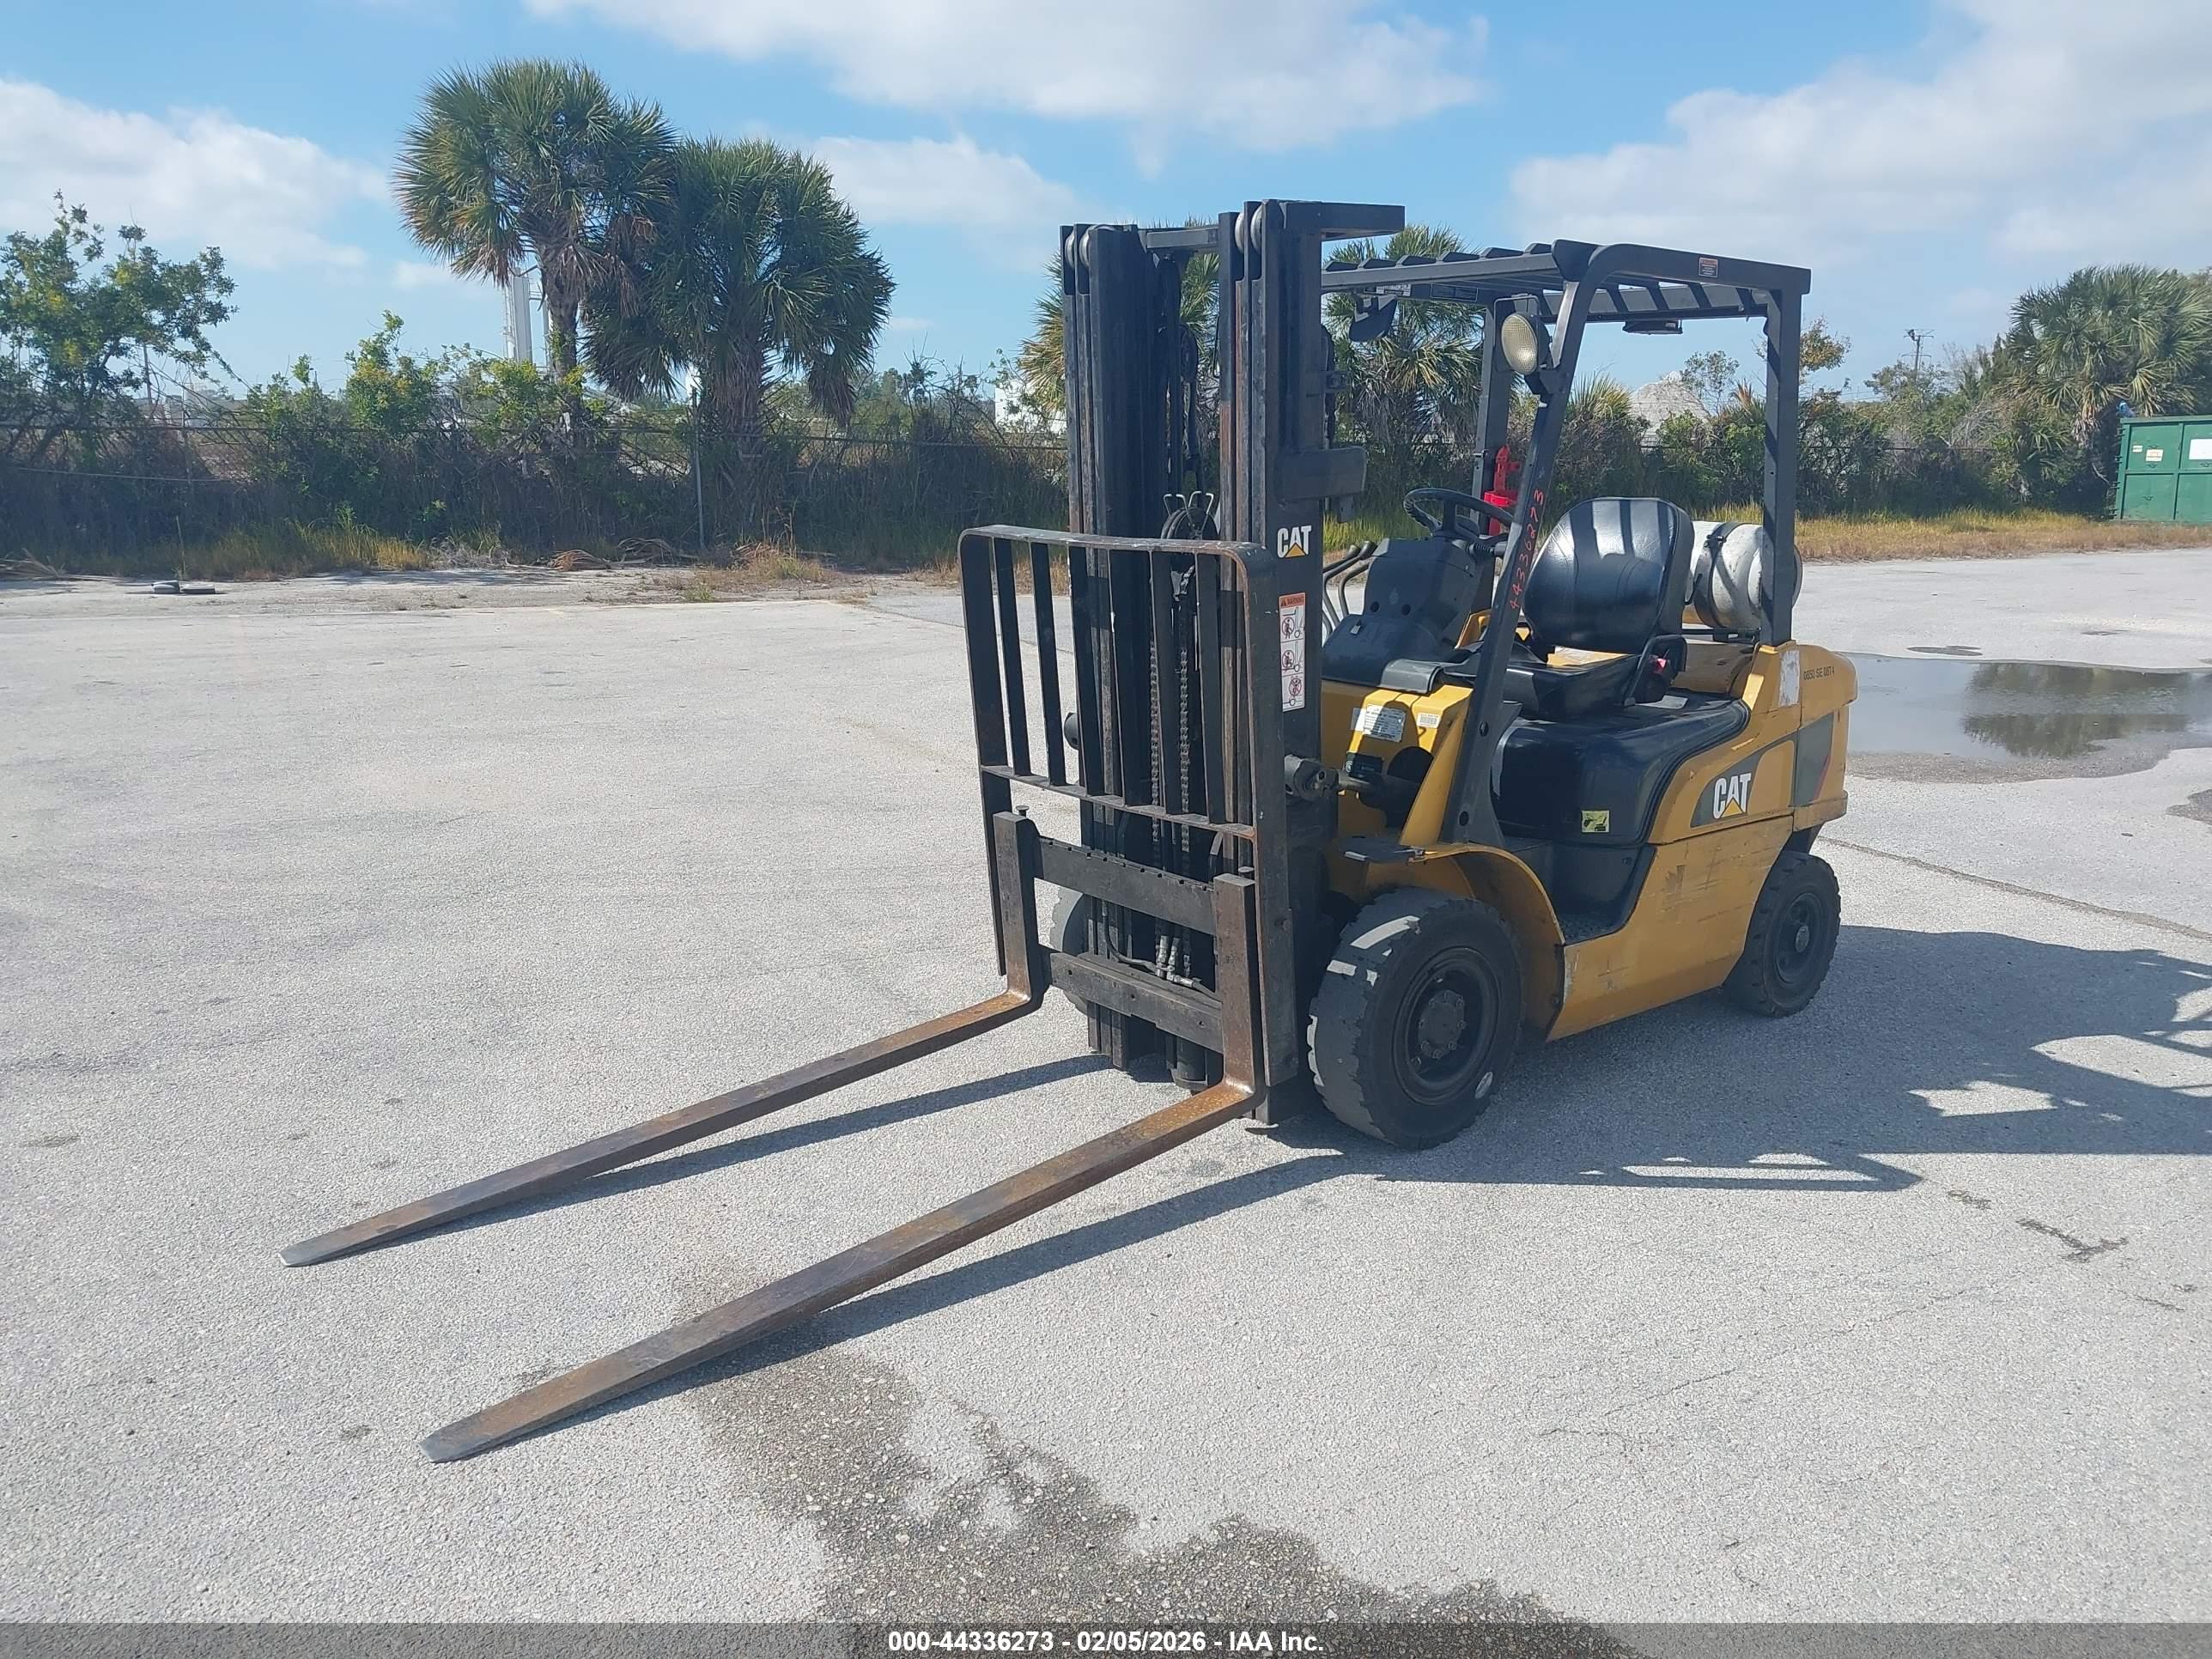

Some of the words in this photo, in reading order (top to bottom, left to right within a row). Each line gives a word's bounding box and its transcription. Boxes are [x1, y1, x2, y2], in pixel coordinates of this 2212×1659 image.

[1277, 526, 1312, 558] CAT
[1510, 489, 1544, 610] 44336273
[1816, 667, 1823, 678] SE
[1713, 773, 1752, 818] CAT
